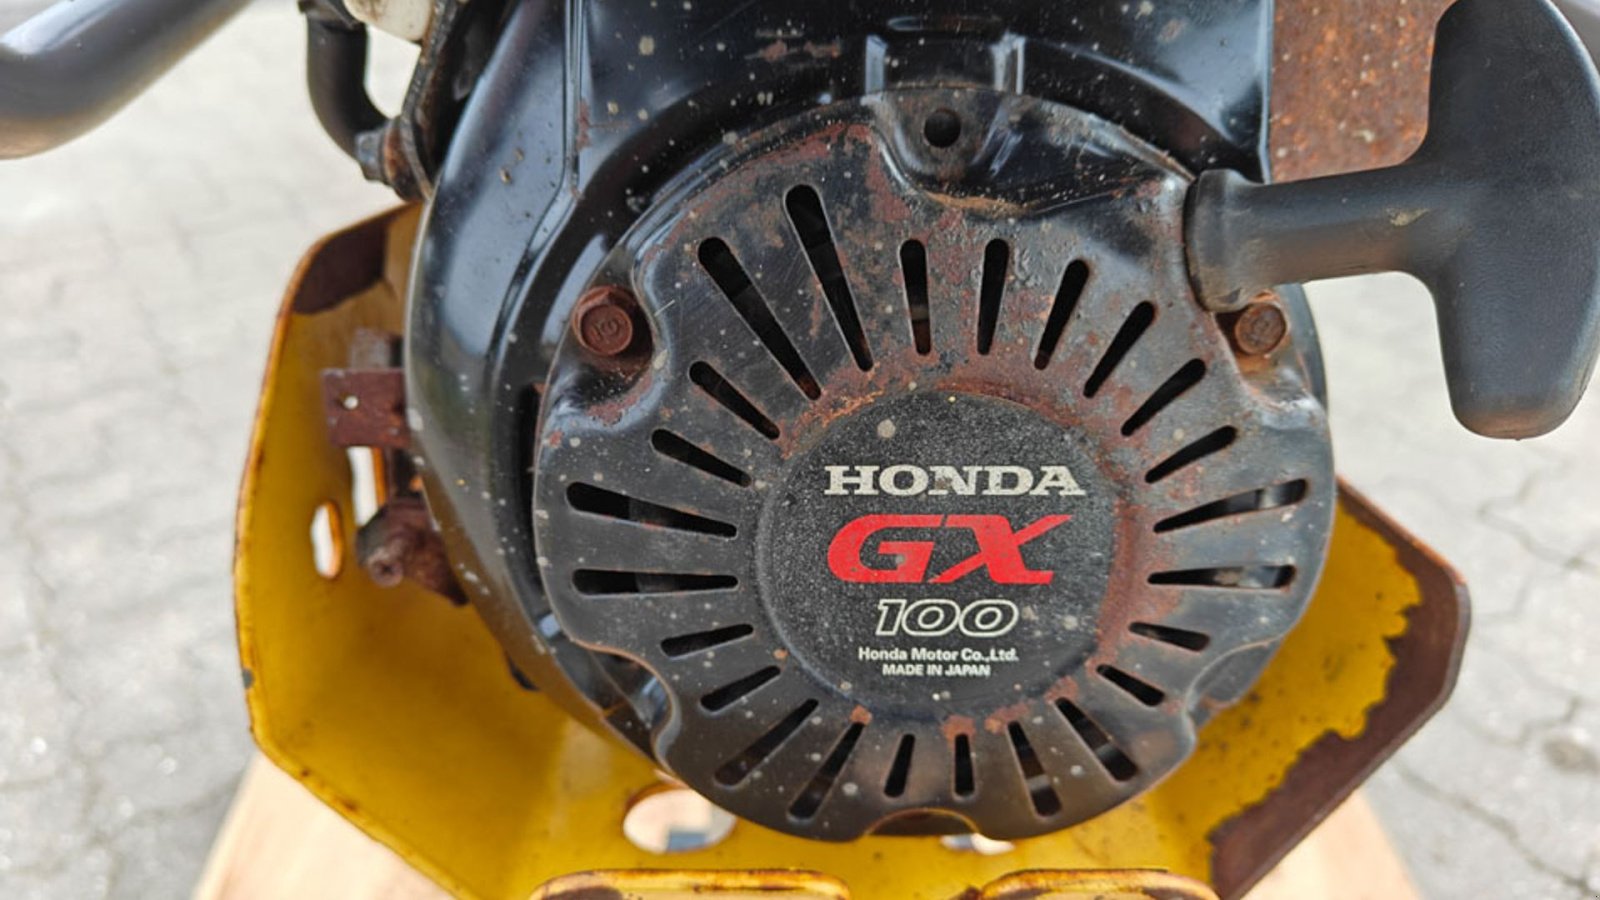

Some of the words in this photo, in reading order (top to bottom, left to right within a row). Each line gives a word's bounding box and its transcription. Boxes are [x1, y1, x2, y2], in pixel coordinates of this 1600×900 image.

[824, 464, 1087, 496] HONDA
[827, 514, 1073, 585] GX
[875, 599, 1020, 637] 100
[858, 646, 908, 661] Honda
[911, 647, 959, 662] Motor
[882, 663, 924, 676] MADE
[927, 663, 943, 676] IN
[945, 664, 991, 677] JAPAN
